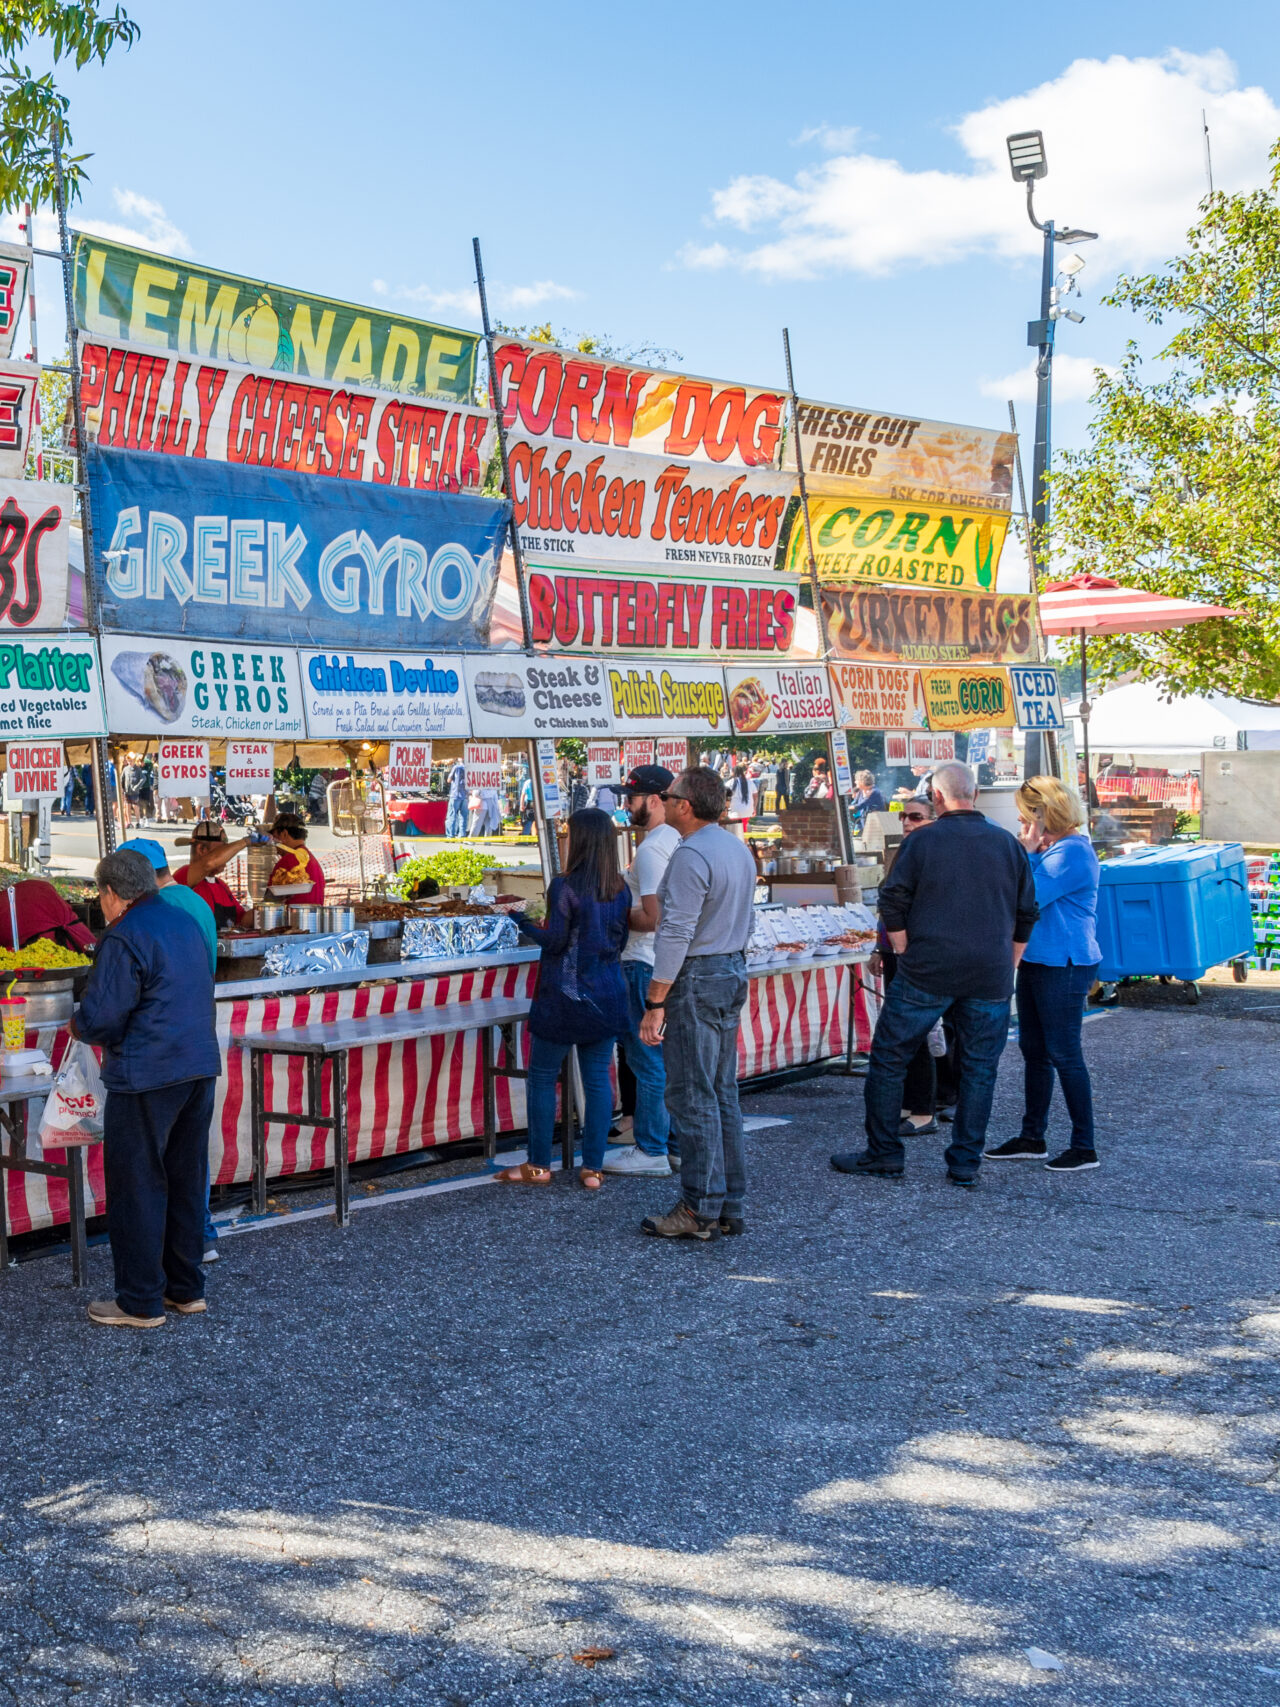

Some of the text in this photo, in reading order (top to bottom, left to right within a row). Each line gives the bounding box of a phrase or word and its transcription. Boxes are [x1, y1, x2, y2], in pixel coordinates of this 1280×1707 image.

[490, 343, 786, 466] CORN DOG
[80, 343, 488, 494] PHILLY CHEESE STEAK
[797, 404, 921, 449] FRESH CUT
[810, 442, 878, 478] FRIES
[505, 442, 786, 549] Chicken Tenders
[890, 485, 946, 504] ASK FOR
[817, 507, 974, 558] CORN
[522, 536, 575, 553] THE STICK
[102, 506, 312, 612] GREEK
[665, 548, 772, 568] FRESH NEVER FROZEN
[859, 554, 965, 586] ROASTED
[529, 574, 795, 650] BUTTERFLY FRIES
[959, 598, 1031, 655] LEGS
[191, 650, 286, 683] GREEK
[308, 655, 459, 696] Chicken Devine
[526, 664, 600, 690] Steak &
[776, 669, 824, 695] Italian
[841, 666, 909, 691] CORN DOGS
[931, 679, 952, 695] FRESH
[1014, 672, 1056, 697] ICED
[194, 683, 289, 714] GYROS
[533, 690, 602, 710] Cheese
[608, 669, 726, 729] Polish Sausage
[852, 691, 906, 711] CORN DOGS
[958, 677, 1005, 715] CORN
[19, 698, 88, 718] Vegetables
[312, 702, 430, 717] Served on Pita Bread with Grilled
[771, 693, 833, 722] Sausage
[930, 700, 959, 716] ROASTED
[1024, 701, 1057, 727] TEA
[28, 715, 53, 731] Rice
[191, 714, 302, 732] Steak, Chicken Lamb!
[336, 718, 352, 732] Fresh
[355, 718, 375, 732] Salad
[377, 718, 389, 732] and
[534, 716, 609, 729] Or Chicken Sub
[860, 711, 904, 727] CORN DOGS
[161, 745, 204, 759] GREEK
[232, 744, 268, 755] STEAK
[396, 746, 426, 767] POLISH
[467, 747, 498, 764] ITALIAN
[588, 747, 619, 762] BUTTERFLY
[624, 741, 653, 755] CHICKEN
[658, 742, 686, 756] CORN DOG
[886, 737, 907, 759] JUMBO
[911, 738, 954, 760] TURKEY LEGS
[969, 747, 987, 763] TEA
[8, 747, 61, 770] CHICKEN
[246, 757, 253, 765] &
[626, 754, 651, 767] FINGER
[662, 759, 684, 774] BASKET
[13, 769, 58, 793] DIVINE
[161, 764, 207, 779] GYROS
[228, 768, 271, 778] CHEESE
[390, 766, 430, 788] SAUSAGE
[466, 770, 501, 788] SAUSAGE
[595, 765, 612, 779] FRIES
[65, 1093, 95, 1108] CVS
